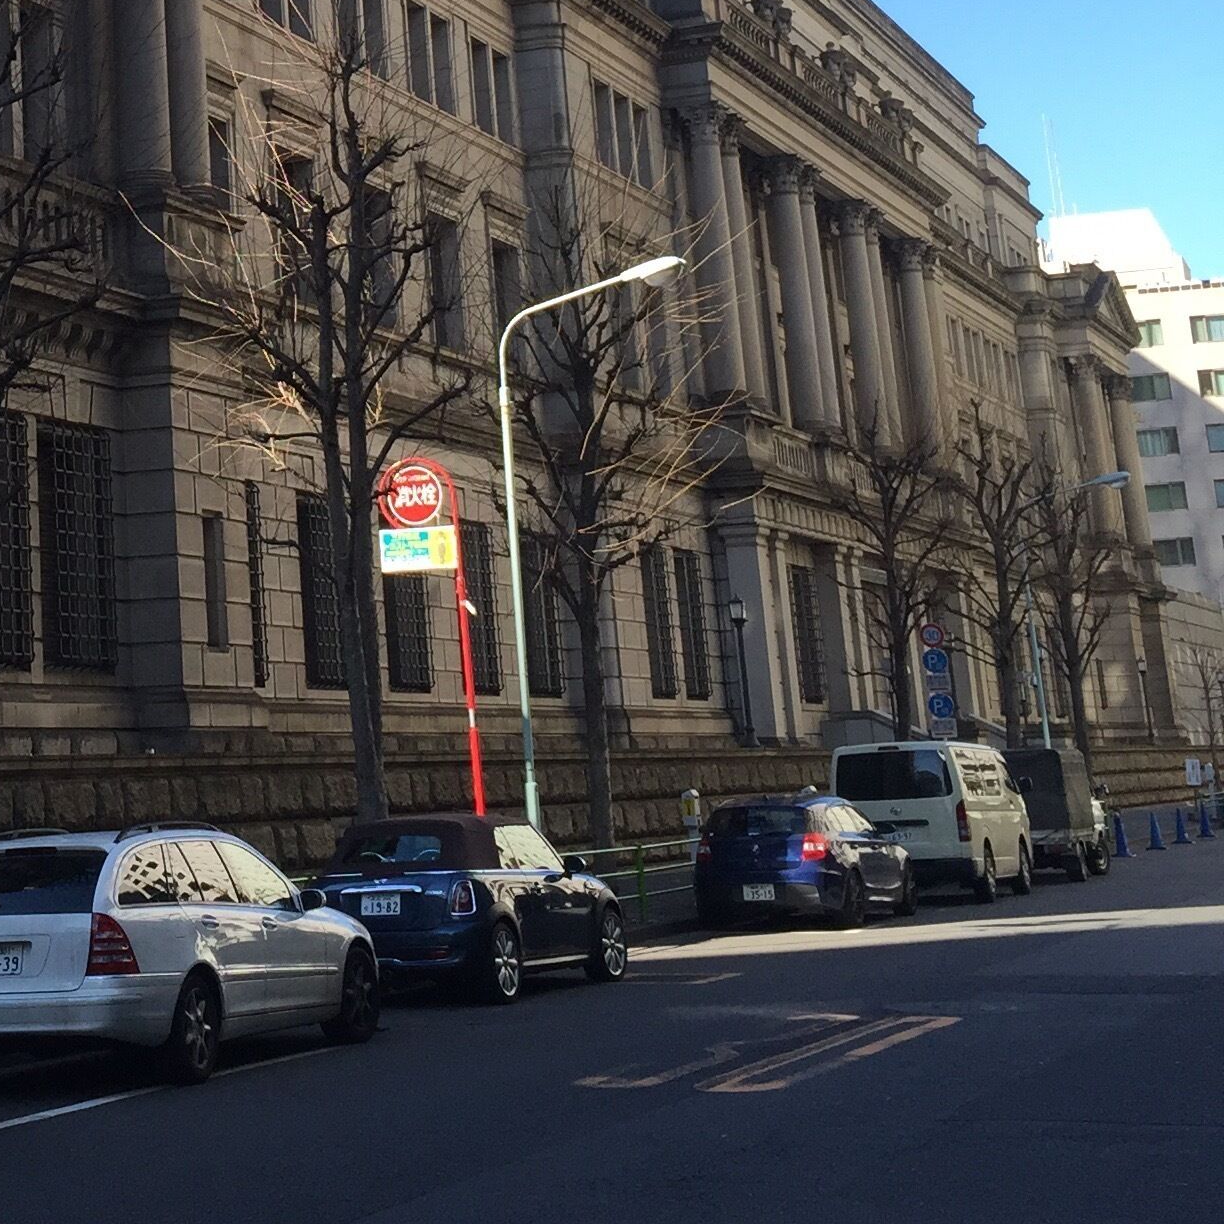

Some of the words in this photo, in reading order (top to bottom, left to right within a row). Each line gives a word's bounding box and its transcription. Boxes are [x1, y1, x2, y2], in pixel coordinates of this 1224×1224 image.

[395, 483, 437, 508] 消火栓
[934, 698, 944, 714] P
